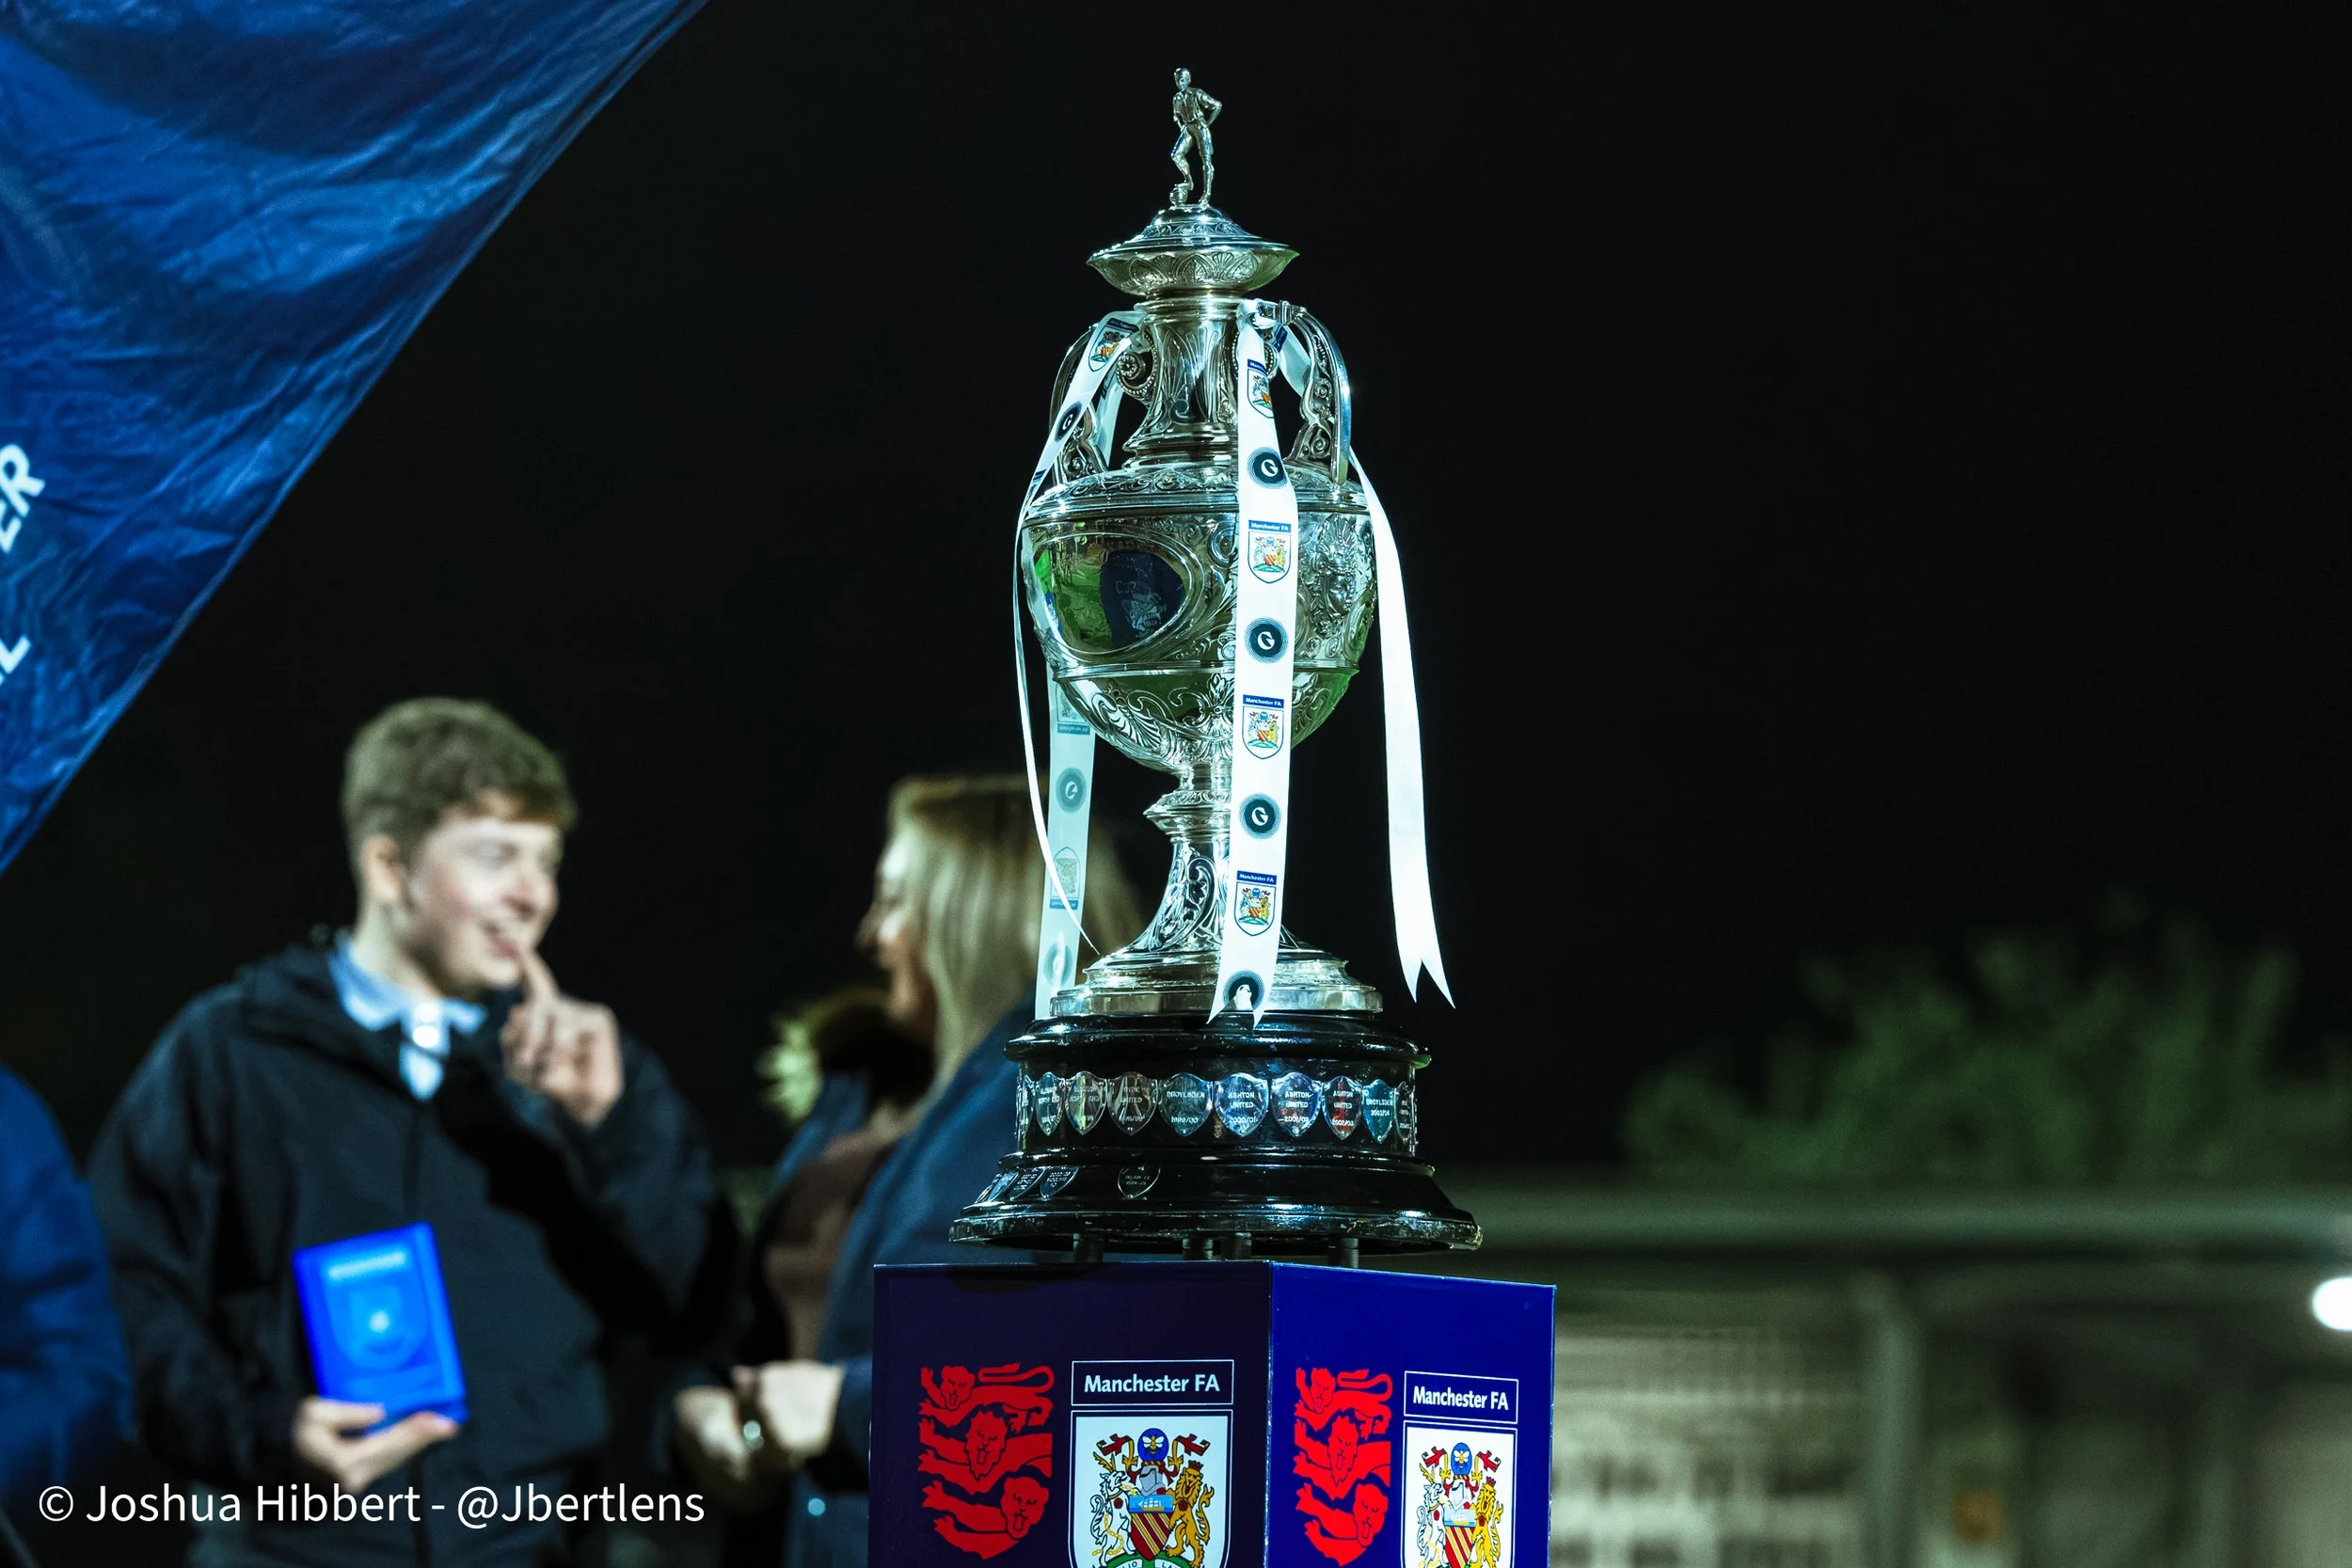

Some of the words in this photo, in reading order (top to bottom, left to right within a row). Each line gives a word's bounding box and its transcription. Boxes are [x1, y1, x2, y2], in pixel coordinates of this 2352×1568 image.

[1245, 697, 1274, 705] Manchester
[1239, 873, 1266, 881] Manchester
[1084, 1373, 1189, 1393] Manchester
[1195, 1373, 1220, 1392] FA
[1412, 1385, 1487, 1409] Manchester
[1490, 1390, 1509, 1411] FA
